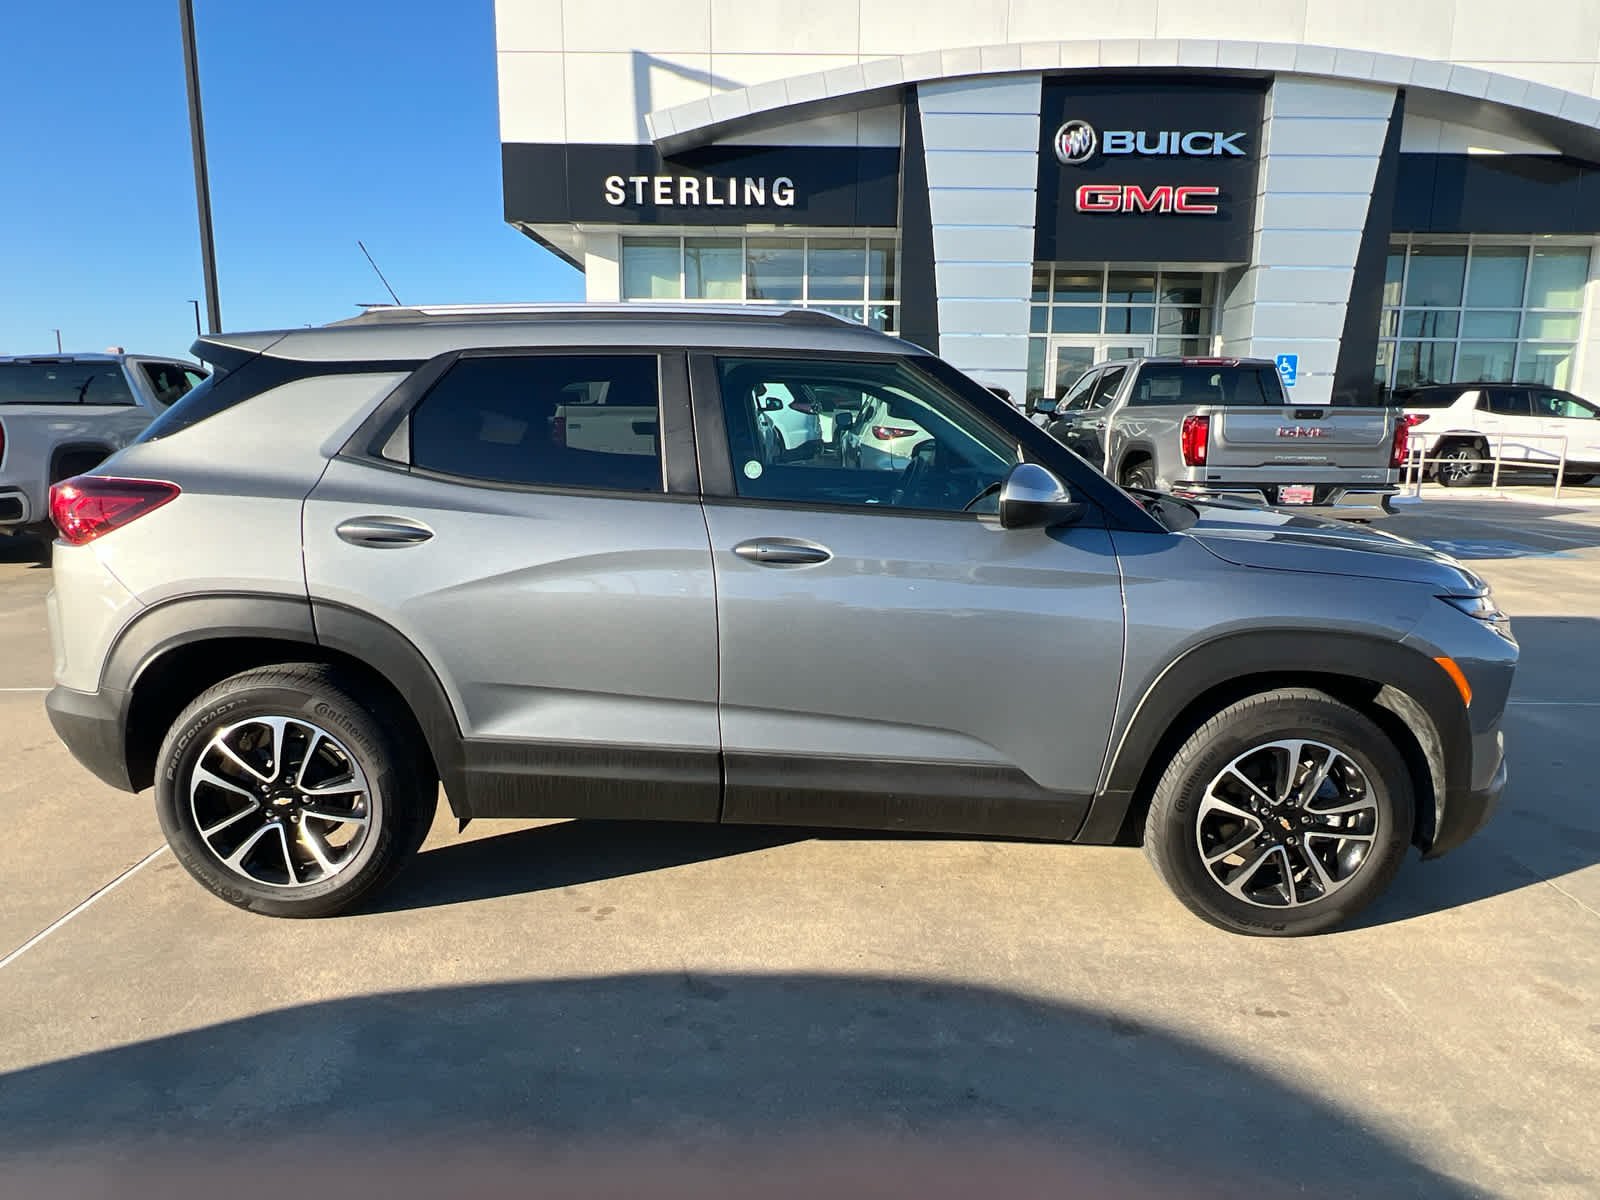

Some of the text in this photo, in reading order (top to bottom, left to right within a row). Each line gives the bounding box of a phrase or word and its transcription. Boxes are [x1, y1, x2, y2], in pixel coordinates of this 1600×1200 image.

[1102, 130, 1247, 156] BUICK
[604, 175, 796, 207] STERLING
[1075, 184, 1220, 214] GMC
[1275, 425, 1335, 438] GMC
